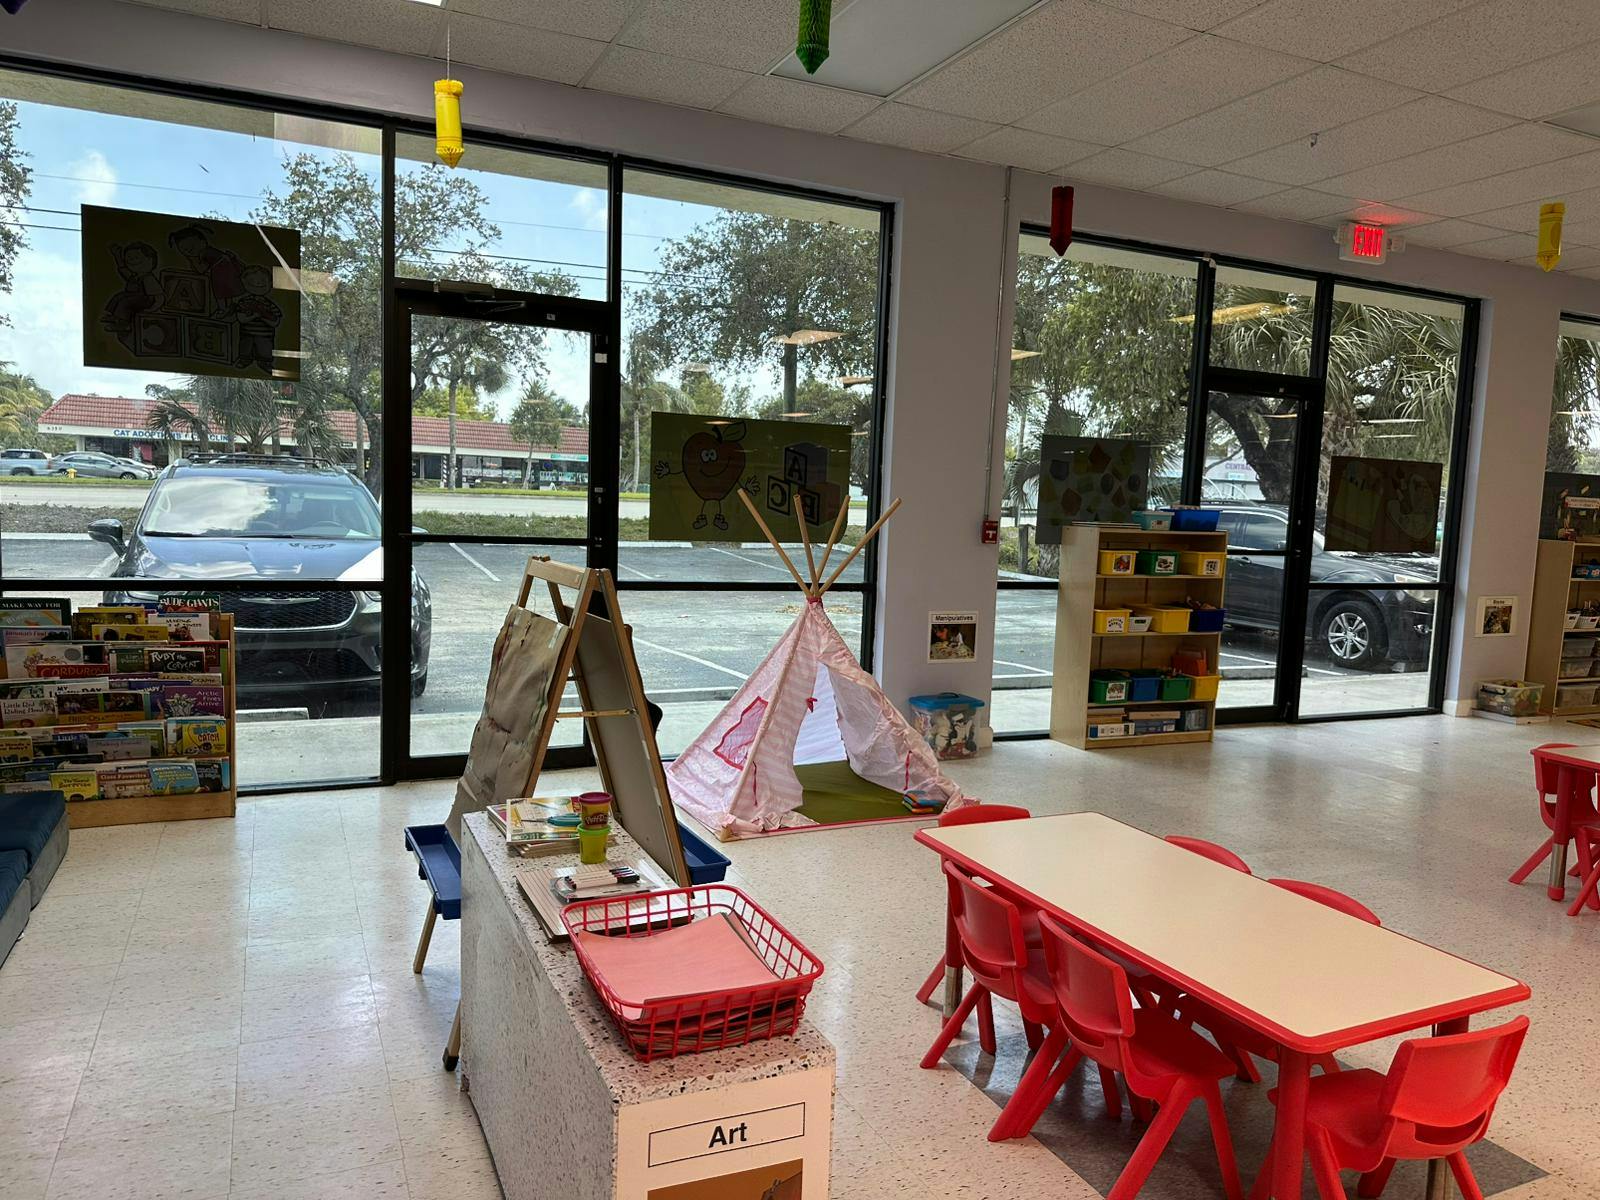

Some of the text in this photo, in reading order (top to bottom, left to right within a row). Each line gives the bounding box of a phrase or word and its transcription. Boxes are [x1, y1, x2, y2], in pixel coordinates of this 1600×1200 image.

[1353, 224, 1384, 257] EXIT
[113, 429, 130, 437] CAT
[708, 1123, 748, 1148] Art
